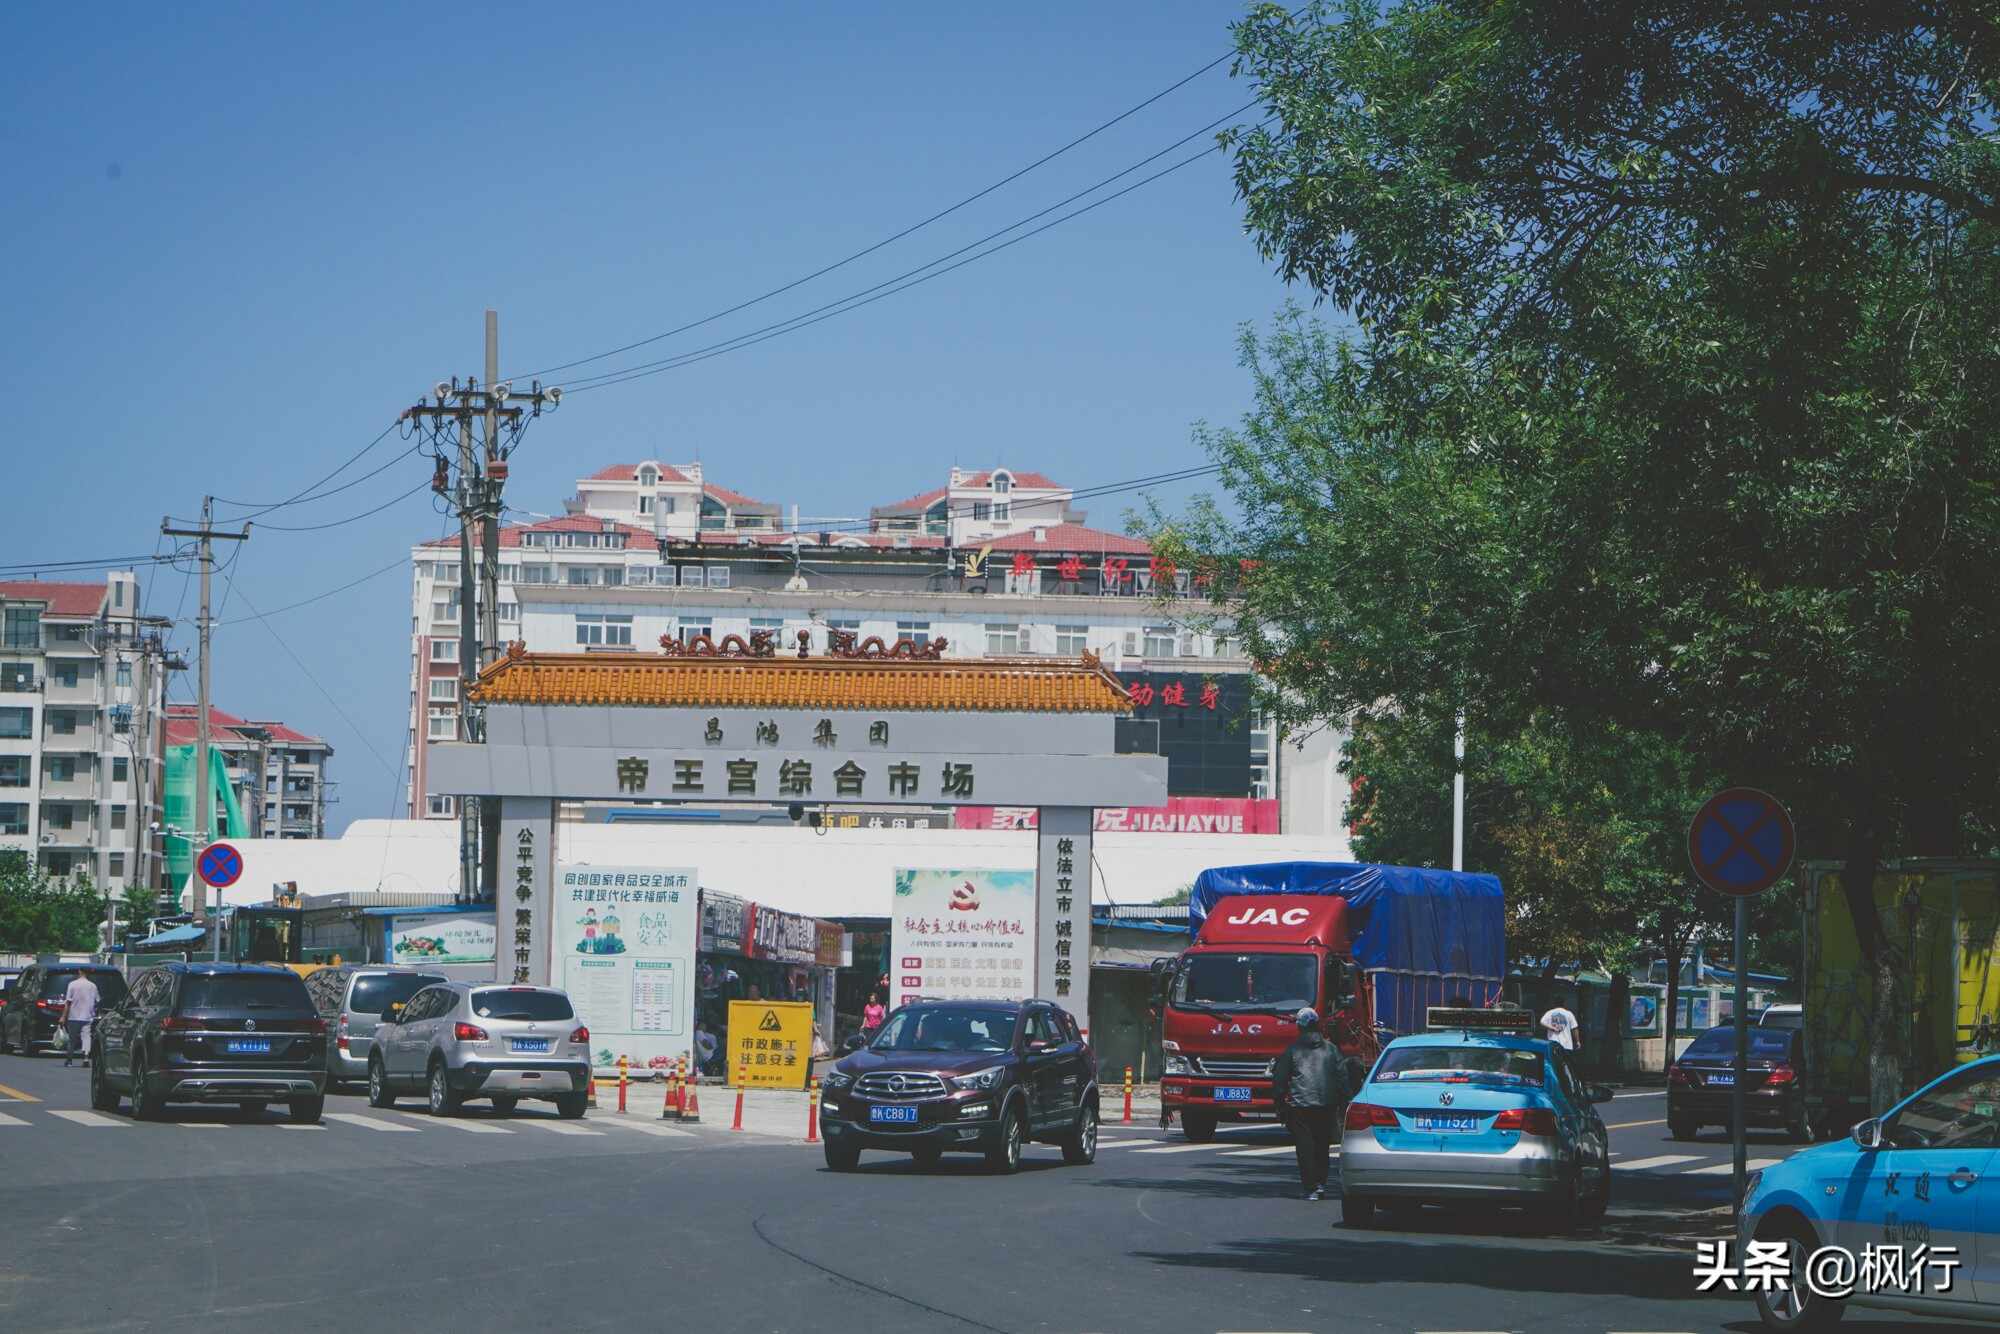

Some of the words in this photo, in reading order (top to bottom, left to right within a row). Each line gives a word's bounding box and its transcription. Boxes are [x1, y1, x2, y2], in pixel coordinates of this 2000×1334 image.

[704, 718, 889, 747] 昌鸿集团
[617, 756, 974, 798] 帝王宫综合市场
[1130, 814, 1243, 832] JIAJIAYUE
[1056, 838, 1073, 914] 依法立市
[1228, 908, 1310, 925] JAC
[1055, 920, 1072, 996] 诚信经营
[1210, 1024, 1262, 1034] JAC
[742, 1038, 797, 1051] 市政施工
[740, 1053, 797, 1066] 注意安全
